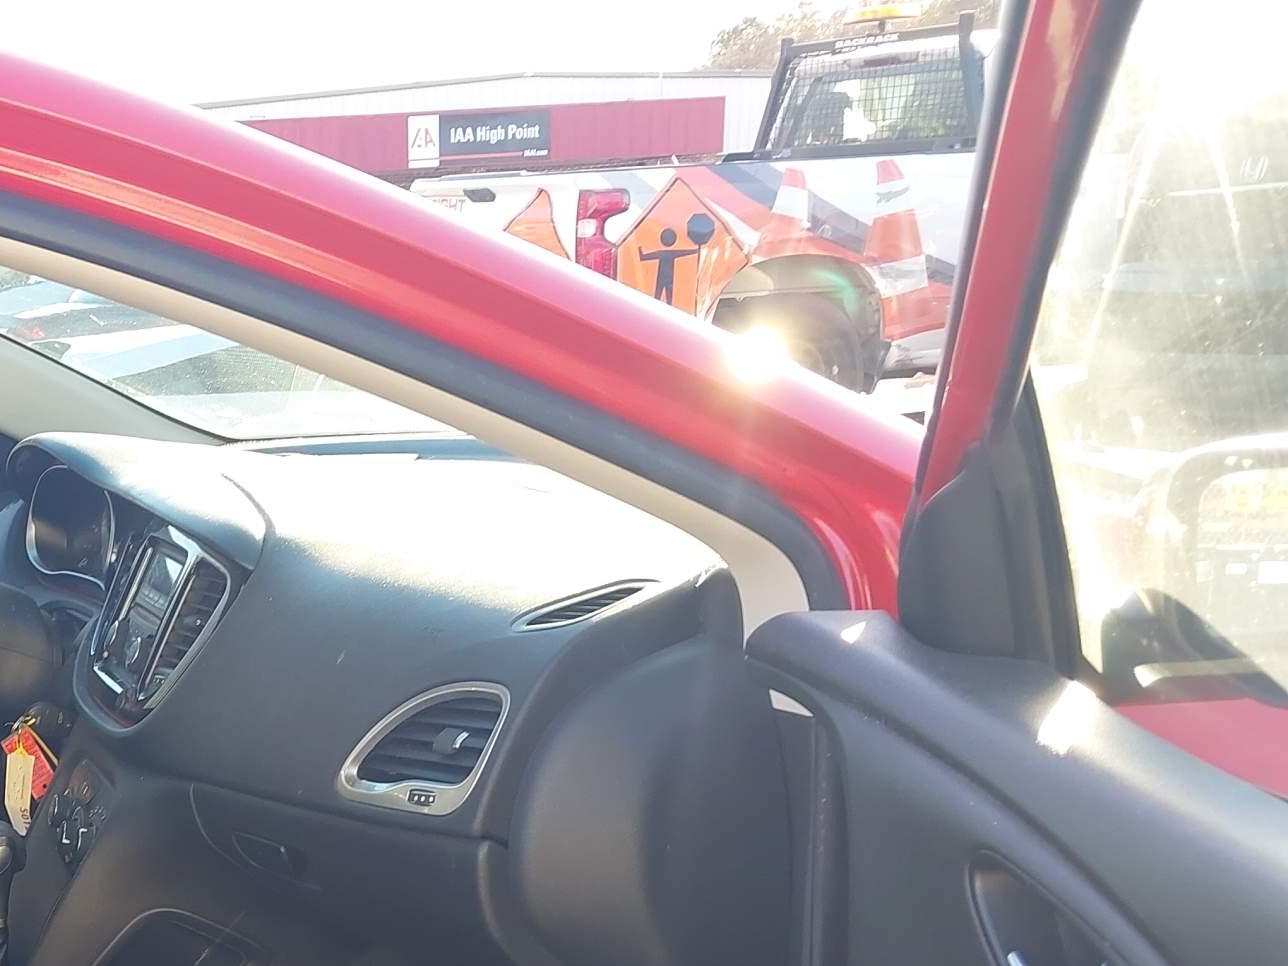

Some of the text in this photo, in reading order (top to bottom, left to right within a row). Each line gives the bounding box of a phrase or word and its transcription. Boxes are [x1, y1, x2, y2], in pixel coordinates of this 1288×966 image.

[450, 123, 540, 144] IAA High Point
